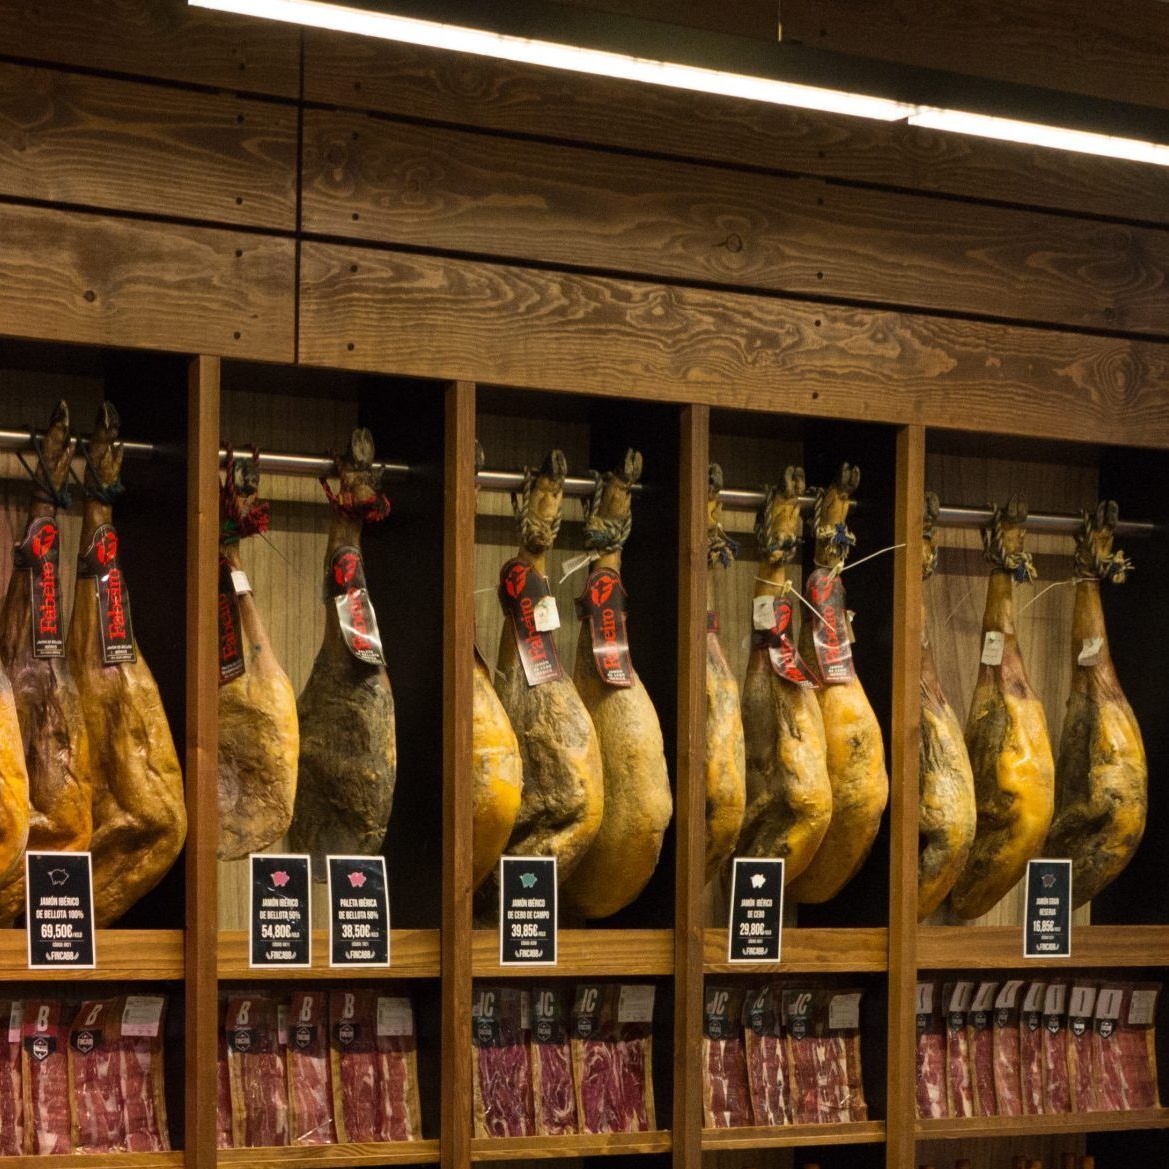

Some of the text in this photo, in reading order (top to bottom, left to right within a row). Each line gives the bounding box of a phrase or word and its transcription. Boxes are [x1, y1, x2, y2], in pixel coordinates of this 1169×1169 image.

[36, 910, 84, 919] DE BELLOTA 100%
[259, 911, 267, 919] DE
[338, 911, 345, 919] DE
[507, 911, 514, 919] DE
[41, 924, 73, 939] 69,50€
[261, 924, 291, 939] 54,80€
[341, 924, 371, 939] 38,50€
[511, 923, 538, 938] 39,85€
[739, 922, 765, 936] 29,80€
